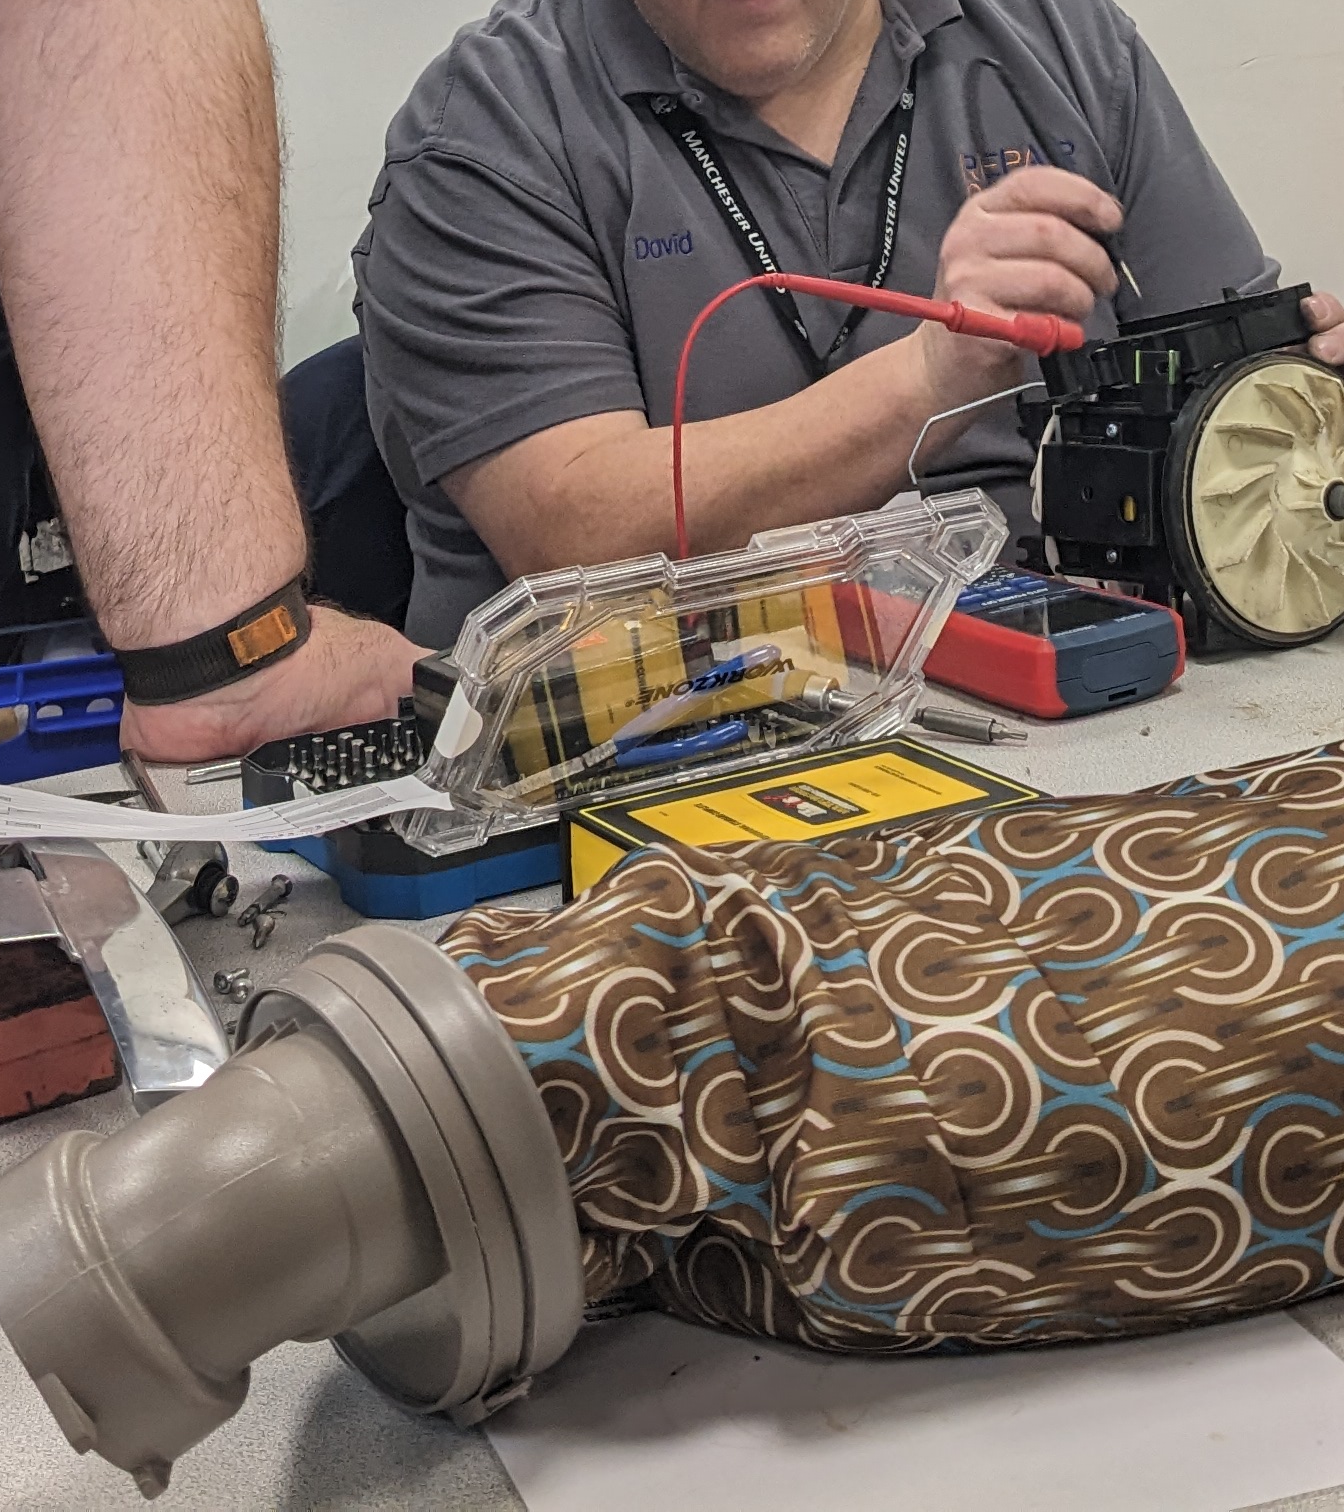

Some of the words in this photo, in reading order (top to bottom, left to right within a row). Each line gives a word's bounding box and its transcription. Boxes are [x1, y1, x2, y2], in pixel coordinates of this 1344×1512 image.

[682, 130, 751, 232] MANCHESTER
[872, 196, 898, 288] ANCHESTER
[887, 133, 908, 196] UNITED
[634, 231, 694, 260] David
